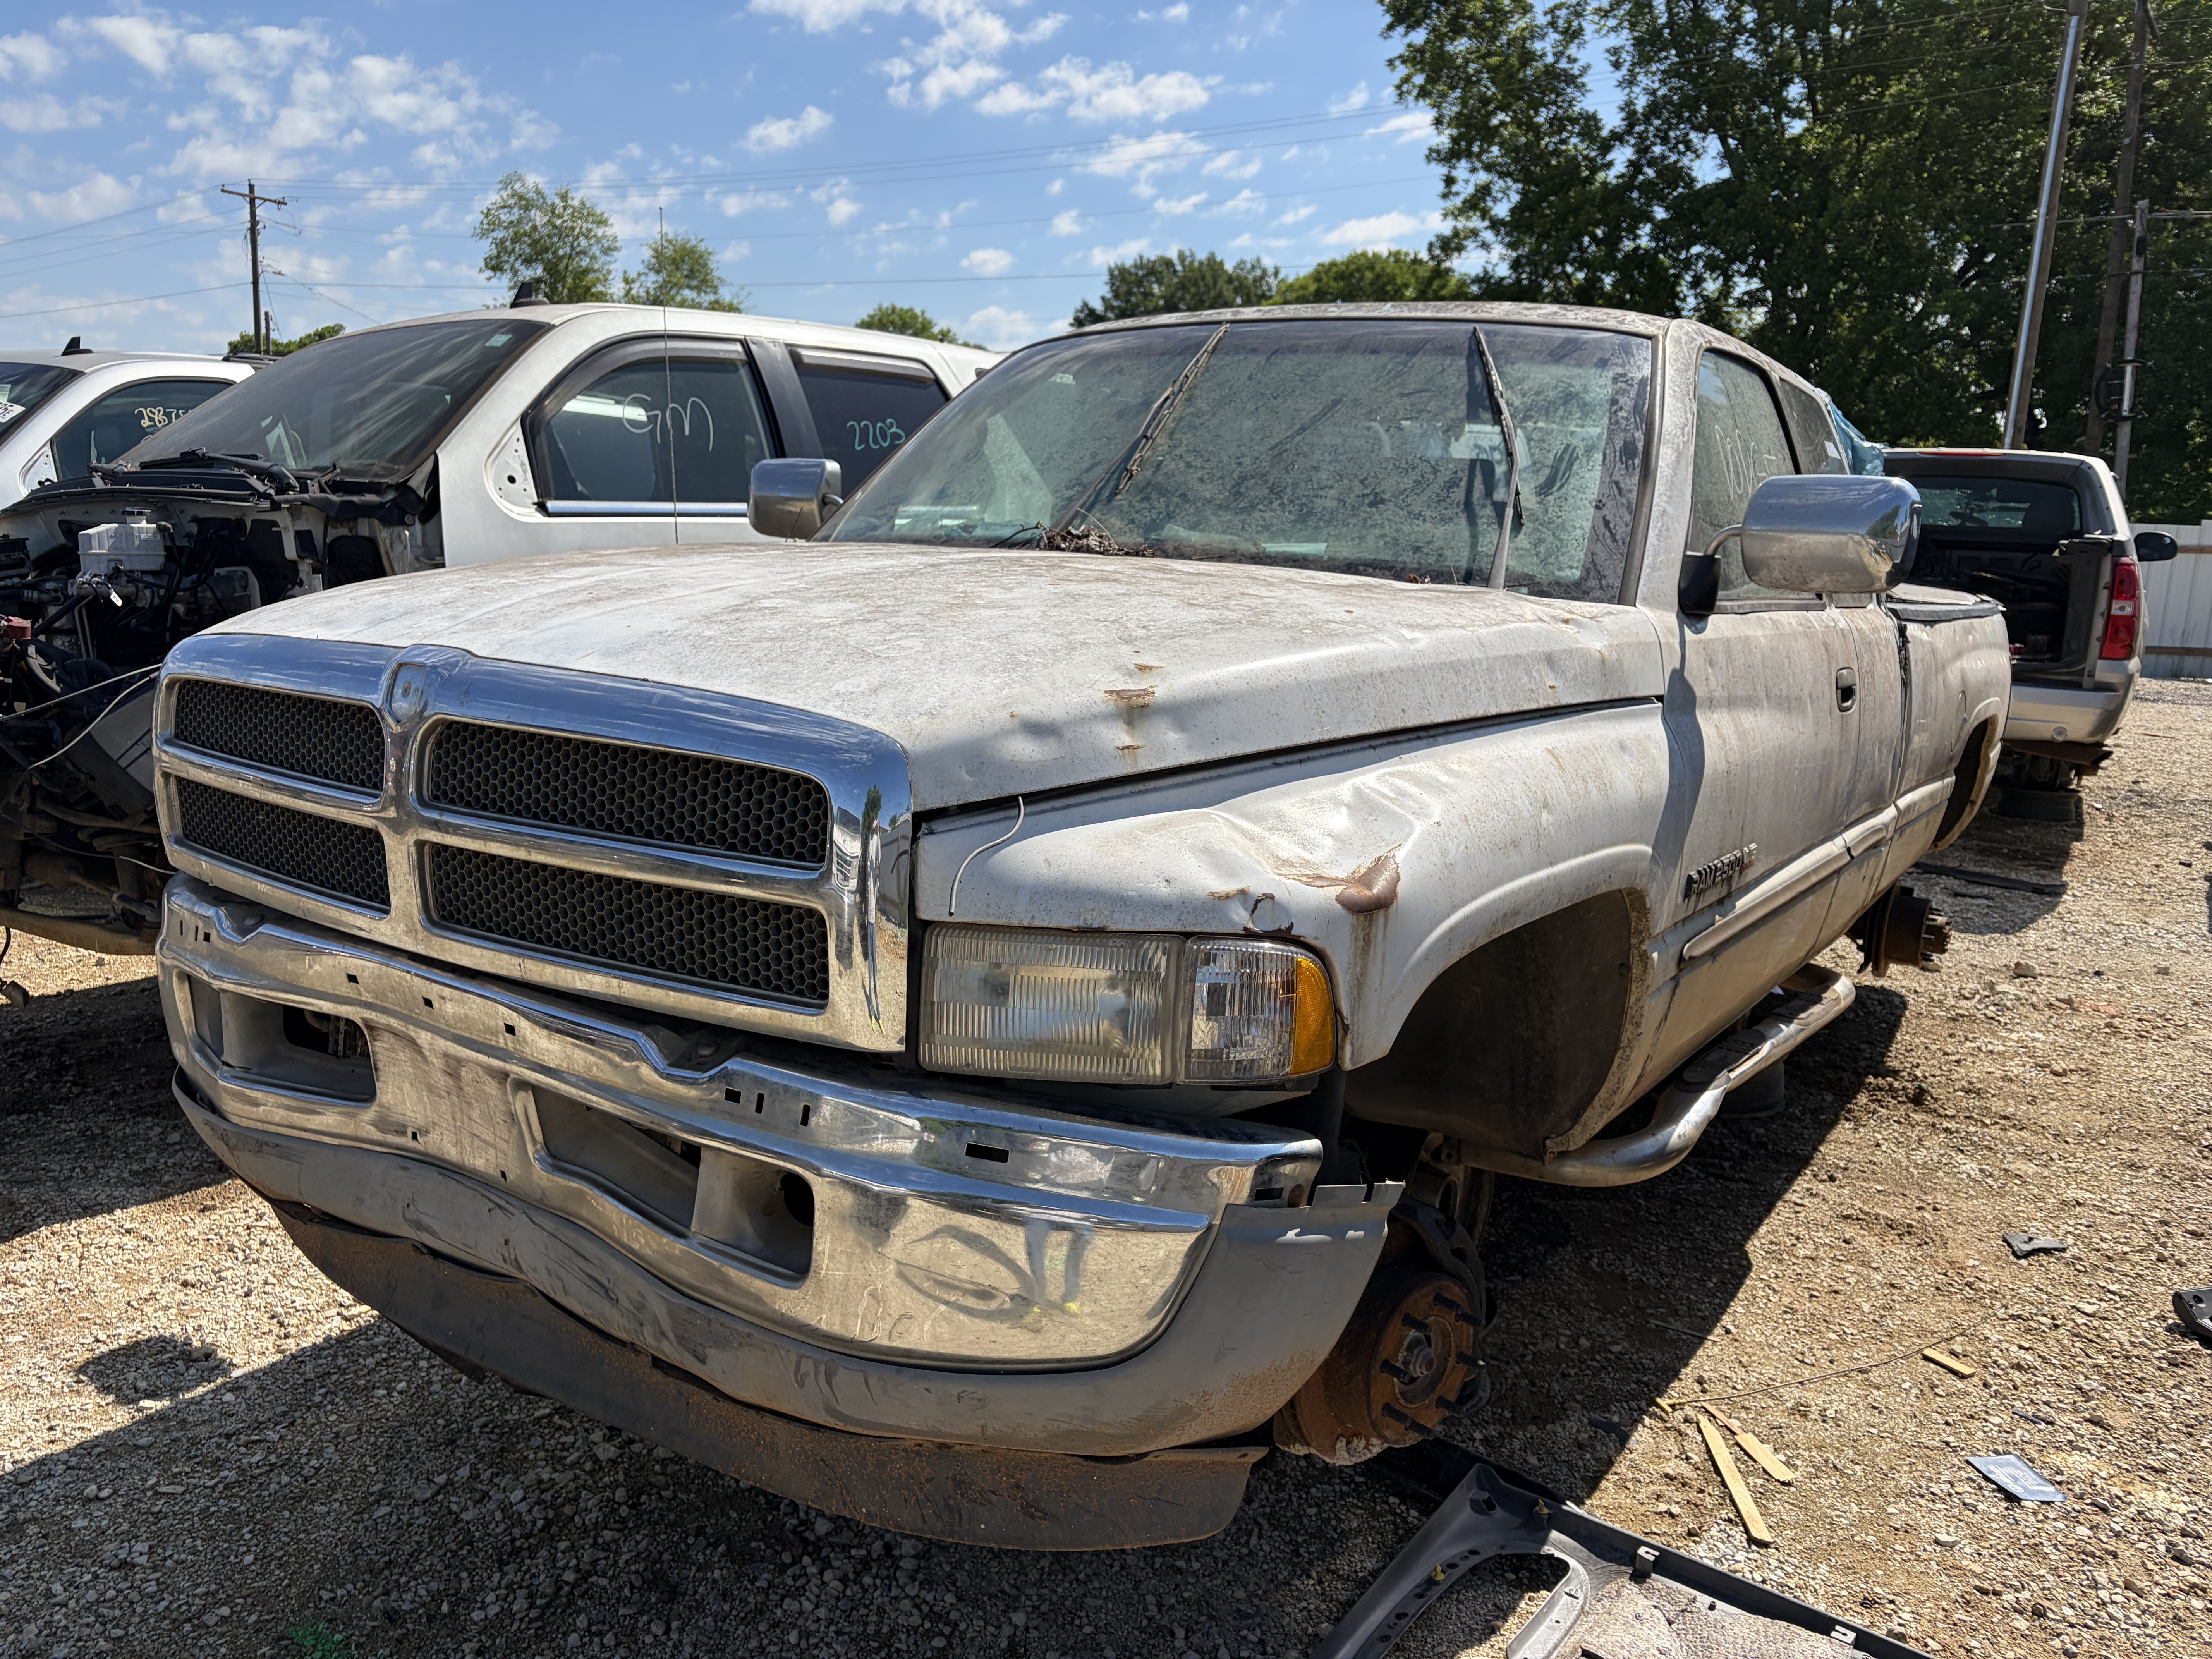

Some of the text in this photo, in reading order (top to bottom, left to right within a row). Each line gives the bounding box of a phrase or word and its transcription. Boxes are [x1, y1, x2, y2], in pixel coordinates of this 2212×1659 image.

[622, 393, 713, 452] GM
[847, 418, 906, 450] 2203
[1687, 863, 1715, 897] RAM
